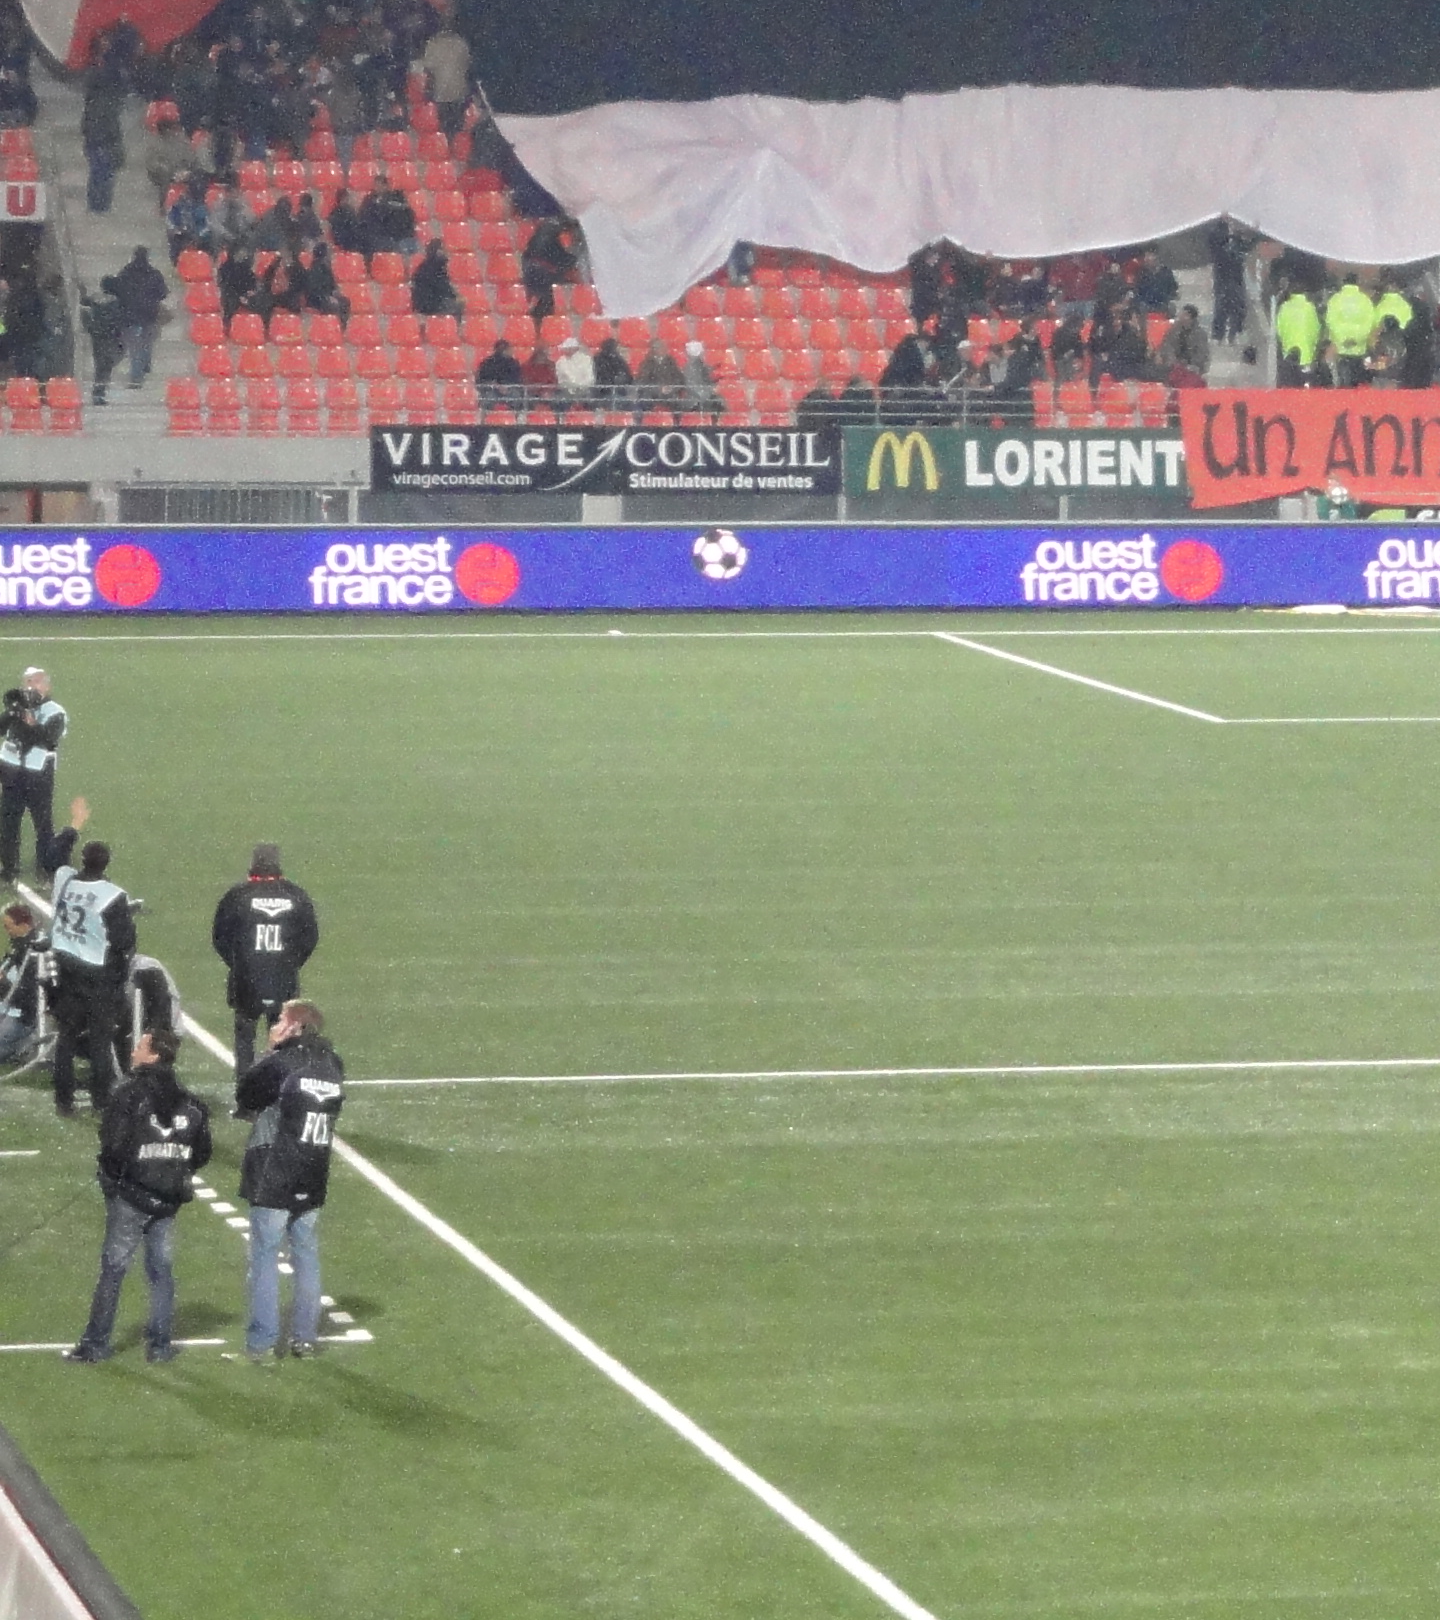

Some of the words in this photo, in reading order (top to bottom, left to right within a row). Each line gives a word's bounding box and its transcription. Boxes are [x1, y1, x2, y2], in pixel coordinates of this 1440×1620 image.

[5, 183, 37, 216] U
[382, 432, 585, 466] VIRAGE
[624, 431, 831, 468] CONSEIL
[964, 440, 1185, 488] LORIENT
[392, 471, 532, 489] virageconseil.com
[629, 472, 726, 489] Stimulateur
[732, 472, 752, 489] de
[756, 473, 814, 489] ventes
[0, 537, 92, 574] uest
[326, 537, 452, 573] ouest
[1035, 533, 1159, 570] ouest
[0, 575, 93, 606] nce
[309, 566, 453, 606] france
[1021, 565, 1159, 601] france
[255, 924, 283, 951] FCL
[301, 1111, 330, 1146] FCL
